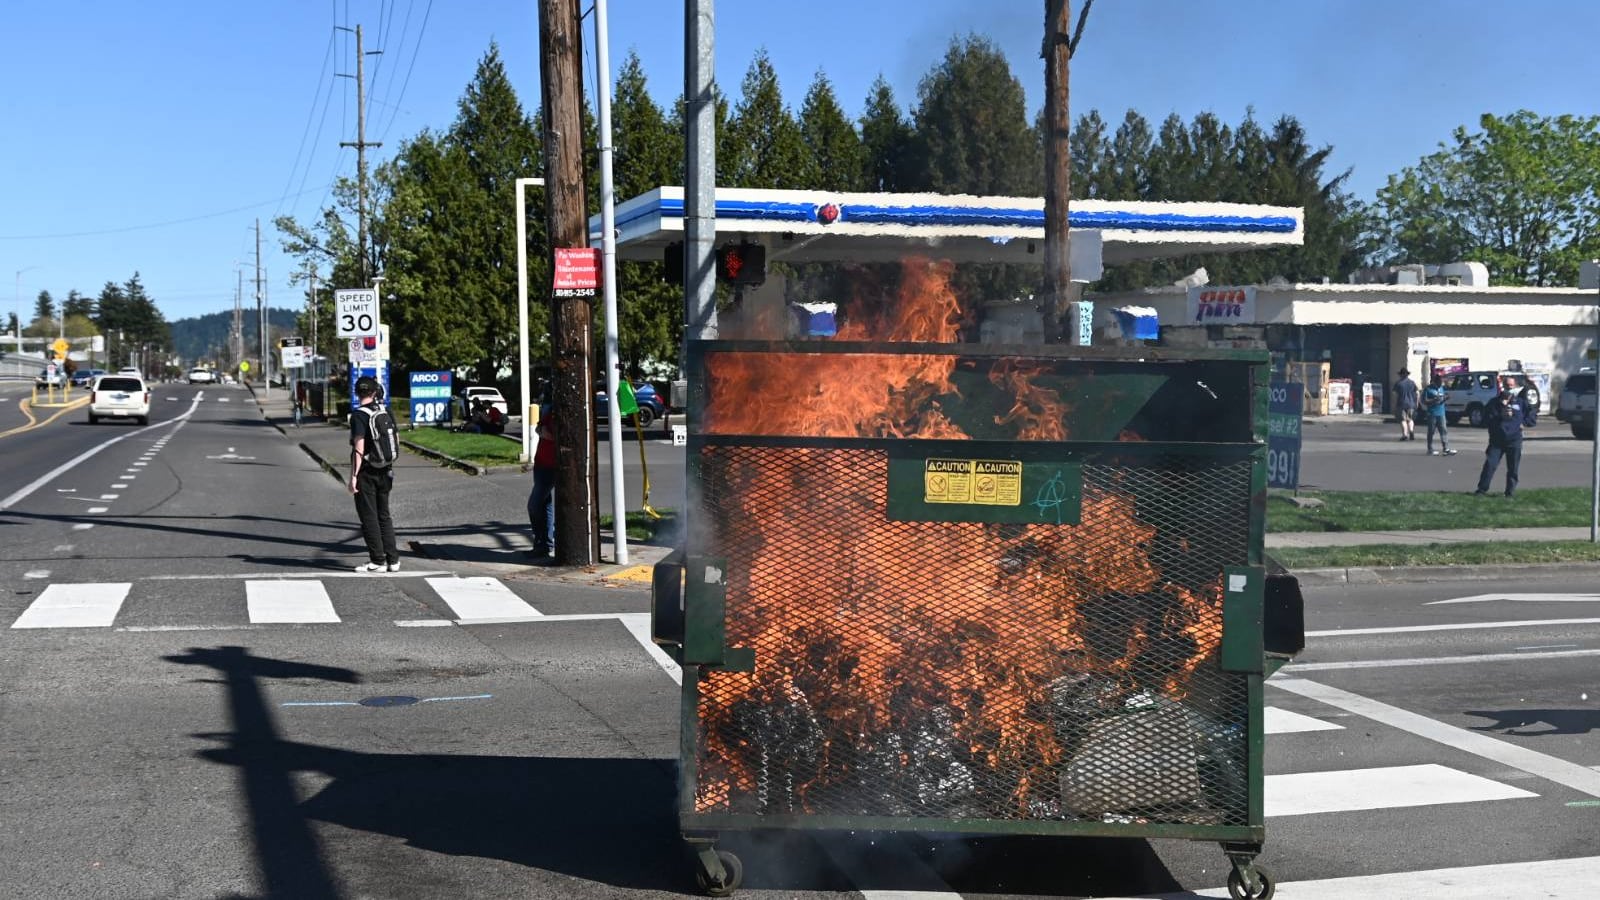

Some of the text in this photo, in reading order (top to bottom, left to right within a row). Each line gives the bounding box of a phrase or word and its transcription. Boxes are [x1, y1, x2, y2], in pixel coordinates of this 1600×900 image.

[340, 294, 372, 302] SPEED
[344, 304, 368, 312] LIMIT
[342, 314, 372, 332] 30
[412, 374, 438, 382] ARCO
[1268, 388, 1286, 402] RCO
[1270, 416, 1285, 432] sel
[936, 462, 970, 472] CAUTION
[984, 463, 1019, 473] CAUTION
